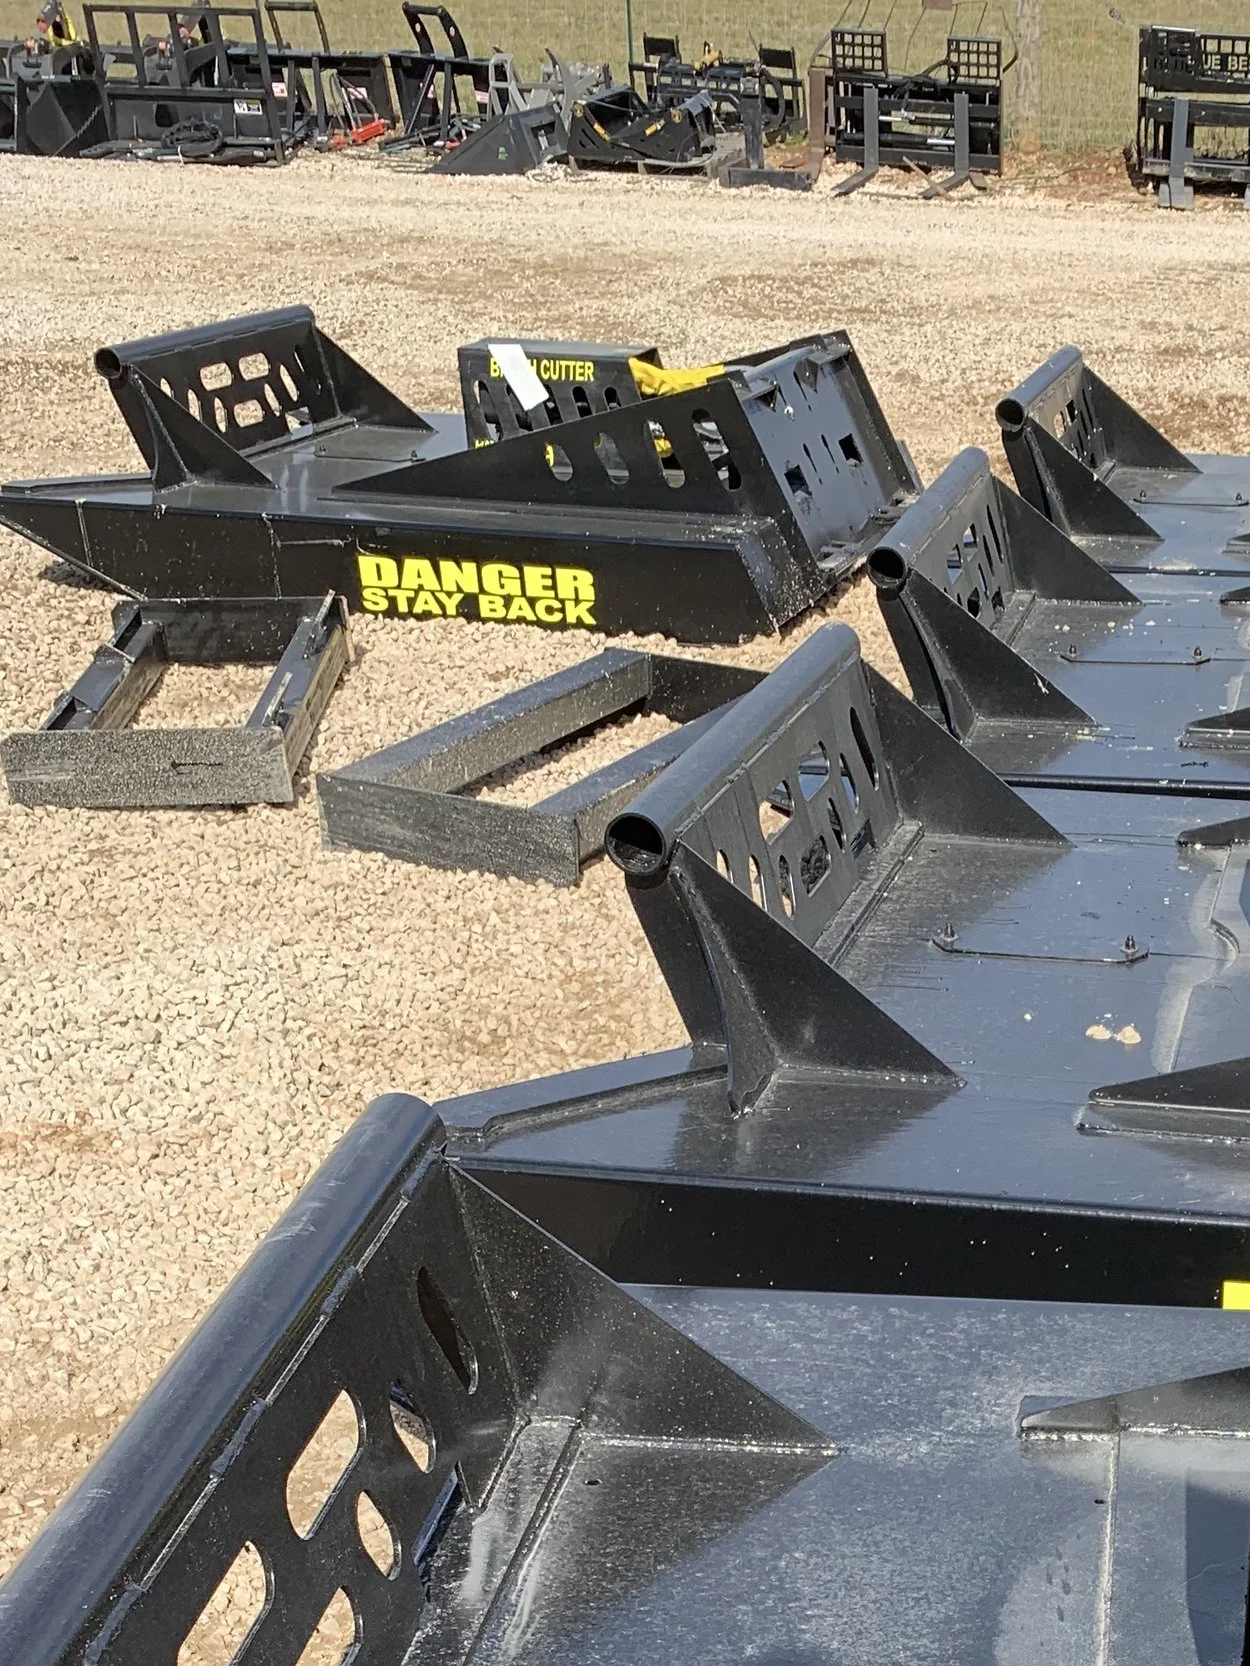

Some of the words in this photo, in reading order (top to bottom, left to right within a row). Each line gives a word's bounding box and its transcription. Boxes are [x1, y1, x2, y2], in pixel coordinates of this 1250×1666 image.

[540, 359, 594, 382] CUTTER
[358, 556, 596, 600] DANGER
[362, 587, 464, 616] STAY
[479, 594, 597, 625] BACK
